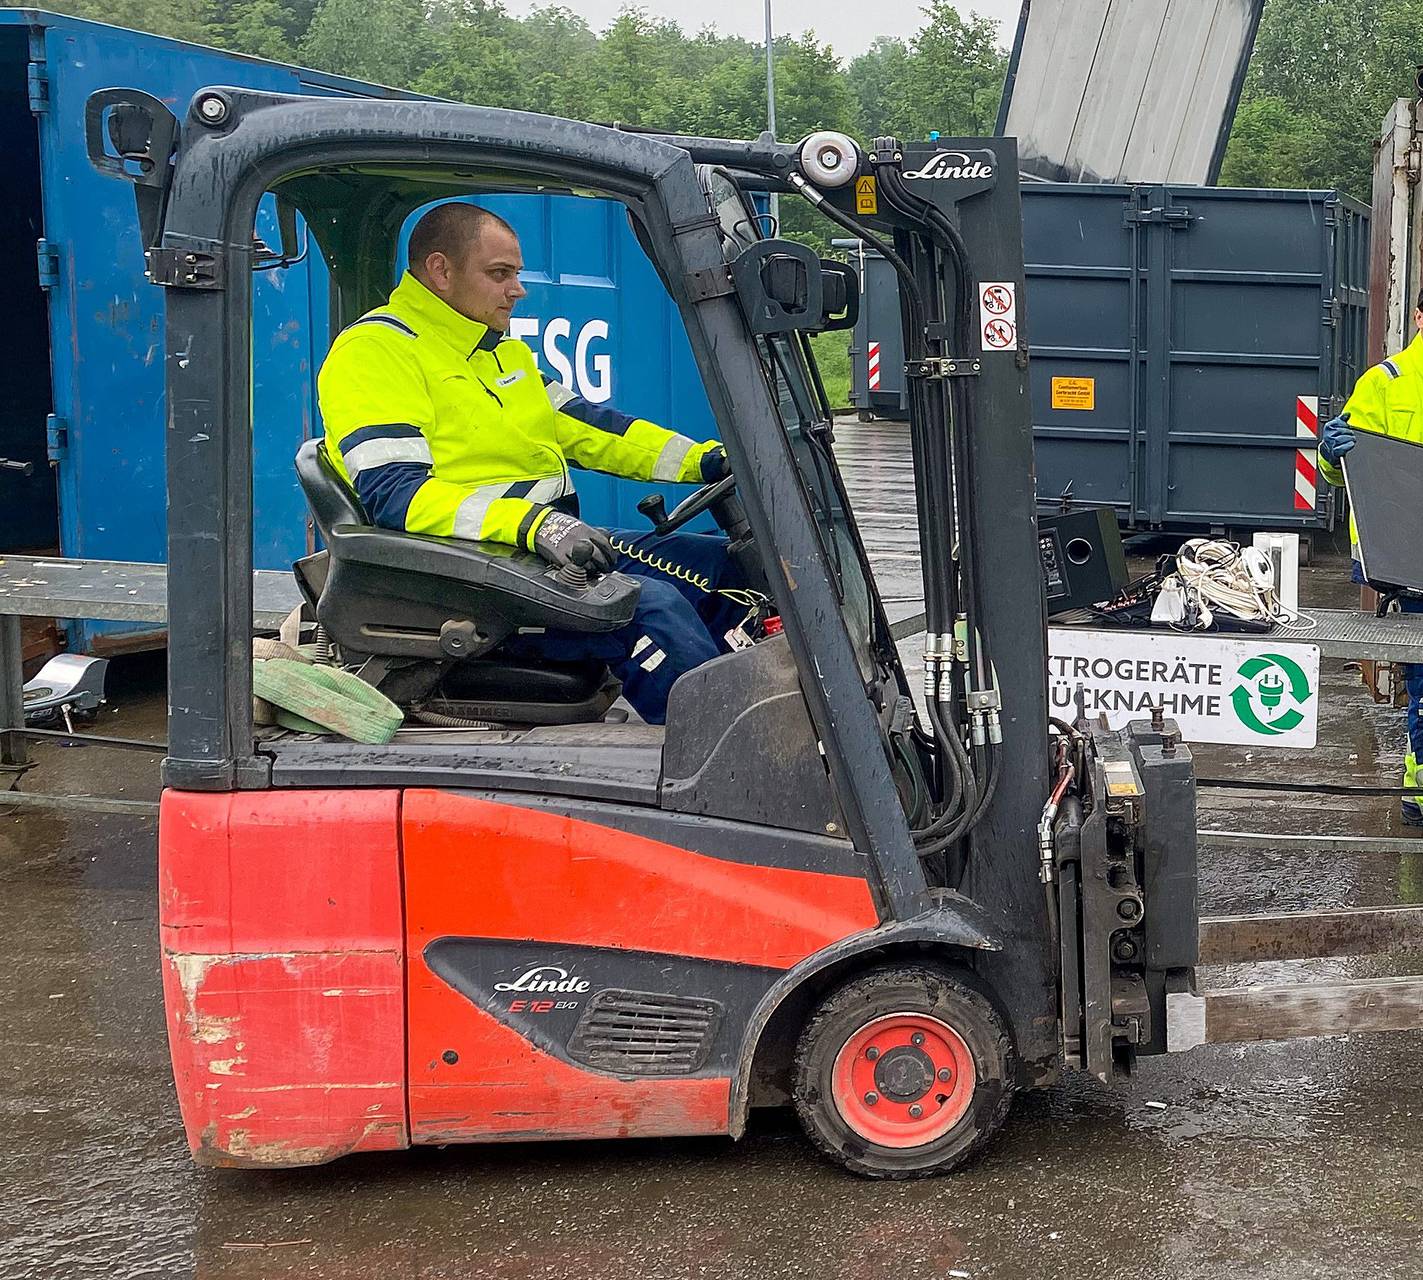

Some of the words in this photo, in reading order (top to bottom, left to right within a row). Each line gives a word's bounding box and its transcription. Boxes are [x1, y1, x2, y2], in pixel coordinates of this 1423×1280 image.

[902, 152, 992, 179] Linde
[1048, 655, 1222, 686] TROGERÄTE
[493, 966, 591, 993] Linde
